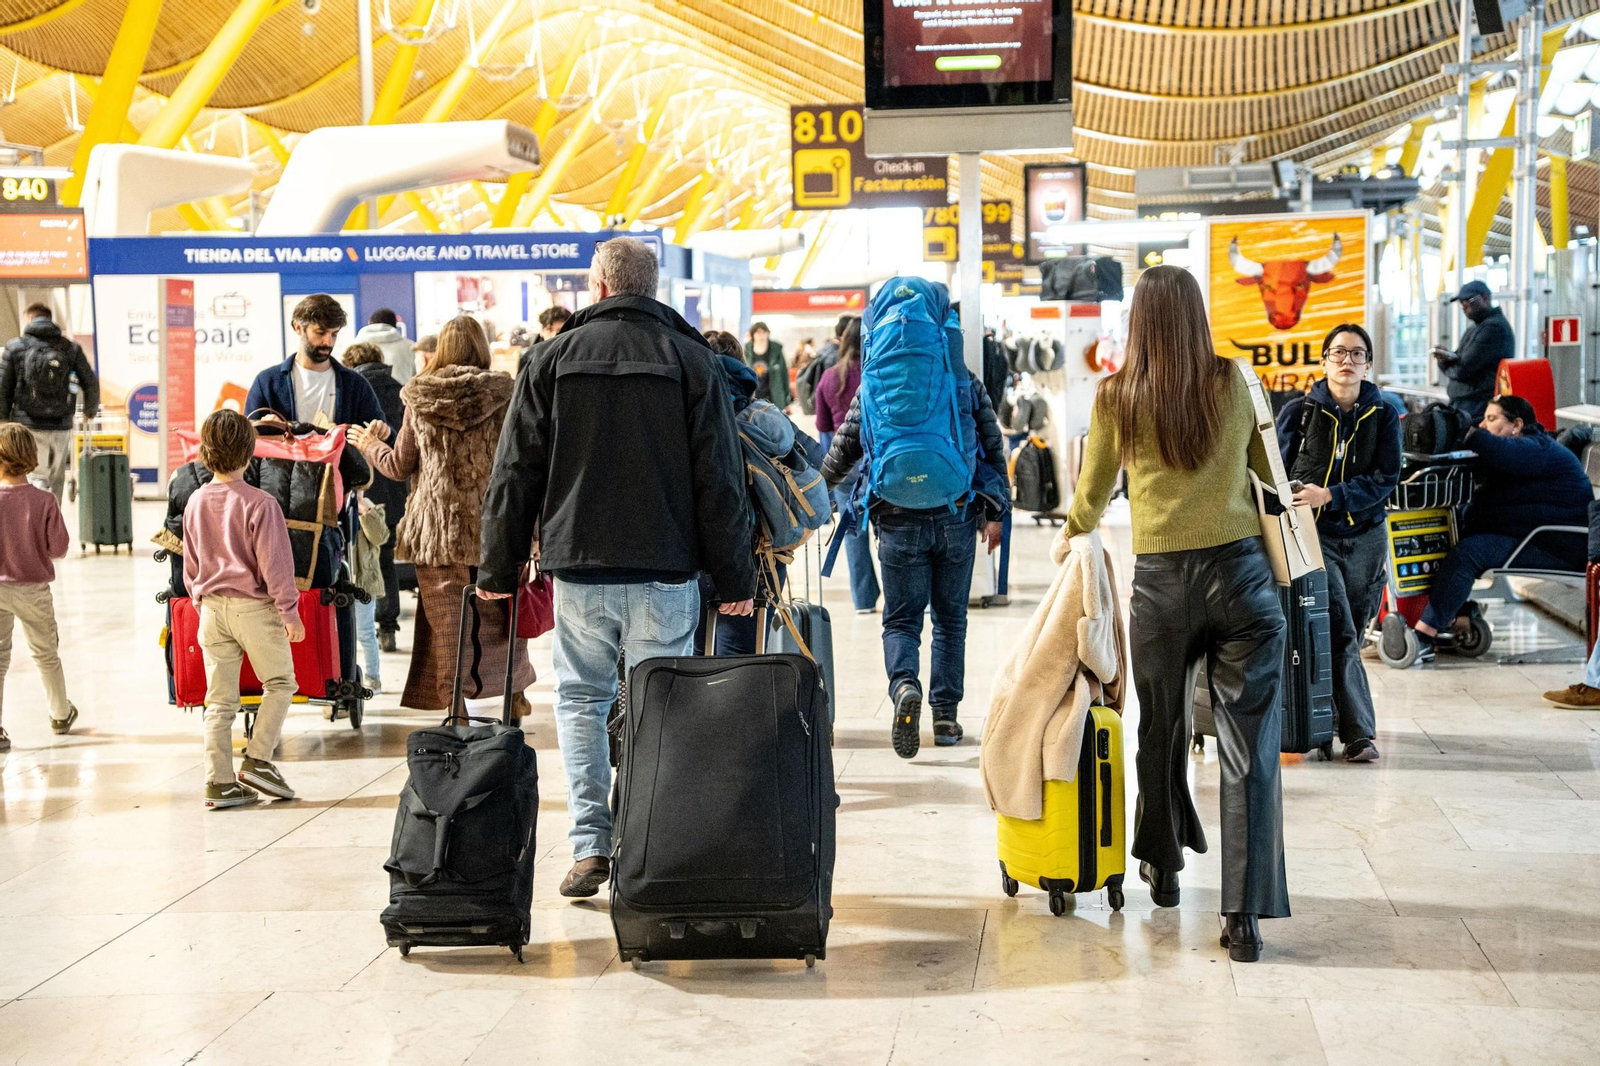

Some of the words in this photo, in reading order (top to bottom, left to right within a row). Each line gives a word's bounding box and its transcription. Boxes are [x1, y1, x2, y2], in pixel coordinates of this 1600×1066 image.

[794, 110, 862, 143] 810
[874, 160, 925, 175] Check-in
[2, 177, 48, 201] 840
[184, 247, 242, 264] TIENDA
[244, 248, 274, 264] DEL
[275, 247, 343, 263] VIAJERO
[365, 245, 436, 262] LUGGAGE
[437, 244, 472, 261] AND
[473, 244, 530, 260] TRAVEL
[531, 243, 579, 259] STORE
[1253, 344, 1320, 366] BUL
